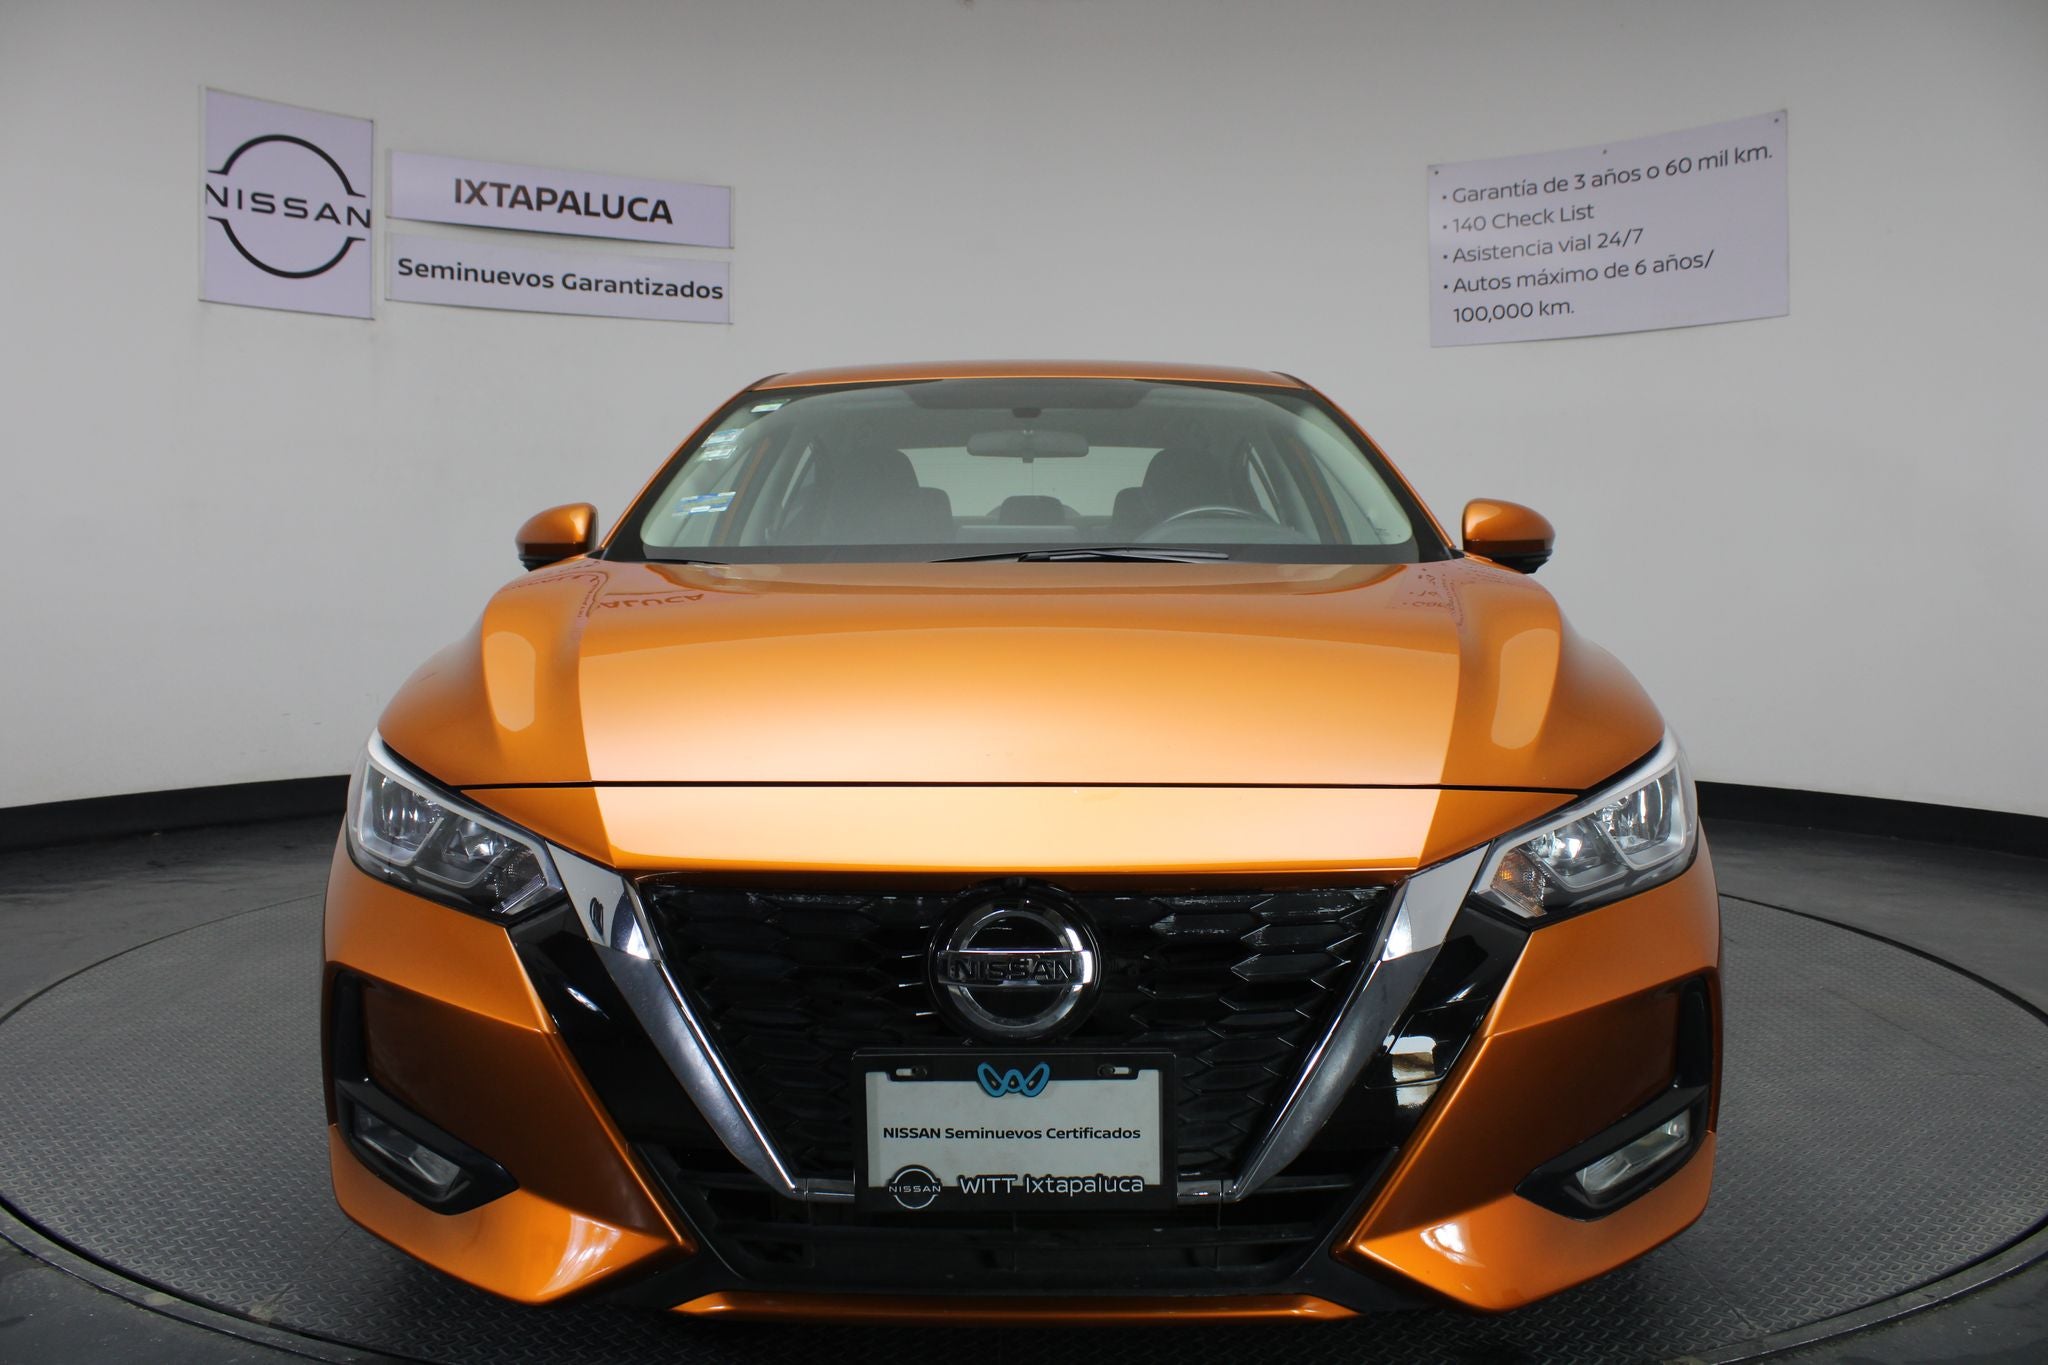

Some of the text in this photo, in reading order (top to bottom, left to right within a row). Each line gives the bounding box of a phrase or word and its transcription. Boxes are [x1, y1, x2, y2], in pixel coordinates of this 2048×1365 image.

[1453, 145, 1773, 204] Garantía de 3 años o 60 mil km.
[205, 183, 372, 229] NISSAN
[454, 178, 674, 225] IXTAPALUCA
[1453, 203, 1595, 233] 140 Check List
[1453, 227, 1644, 264] Asistencia vial 24/7
[398, 258, 724, 300] Seminuevos Garantizados
[1453, 248, 1715, 294] Autos máximo de 6 años/
[1453, 300, 1575, 323] 100,000 km.
[947, 957, 1073, 981] NISSAN
[883, 1126, 1141, 1140] NISSAN Seminuevos Certificados
[889, 1184, 941, 1193] NISSAN
[959, 1175, 1143, 1197] WITT Ixtapaluca
